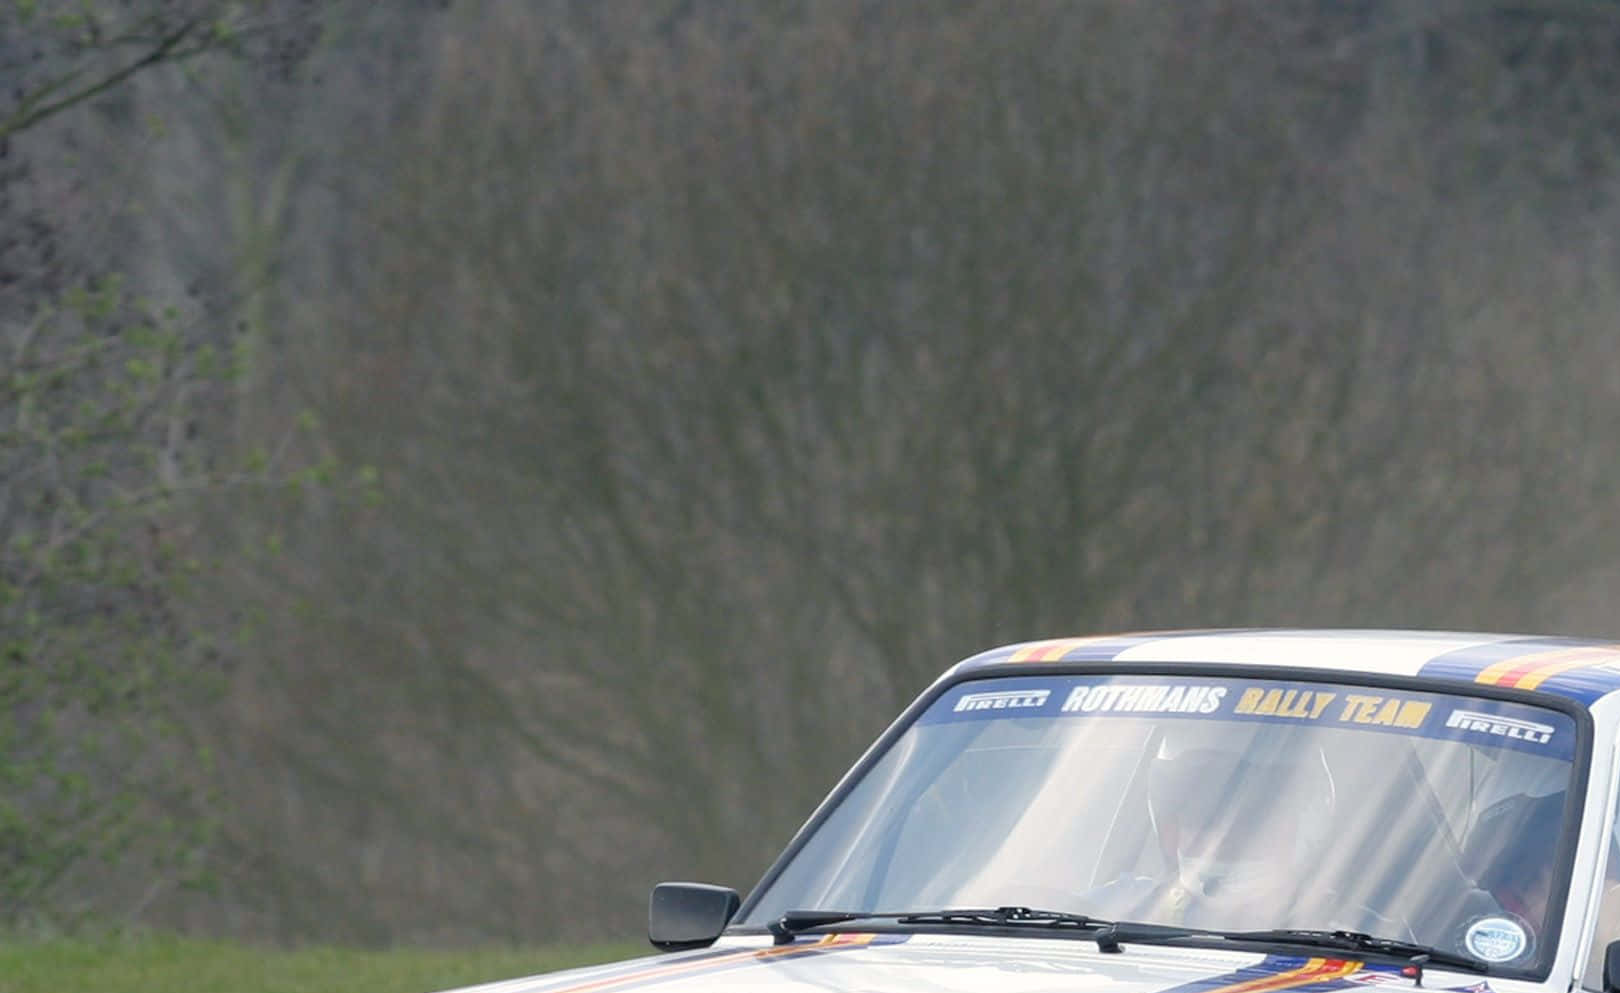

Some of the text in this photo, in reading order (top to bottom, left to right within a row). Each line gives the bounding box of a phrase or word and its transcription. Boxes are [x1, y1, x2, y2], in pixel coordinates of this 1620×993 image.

[953, 685, 1555, 744] PIRELLI ROTHMANS RALLY TEAM PIRELLI
